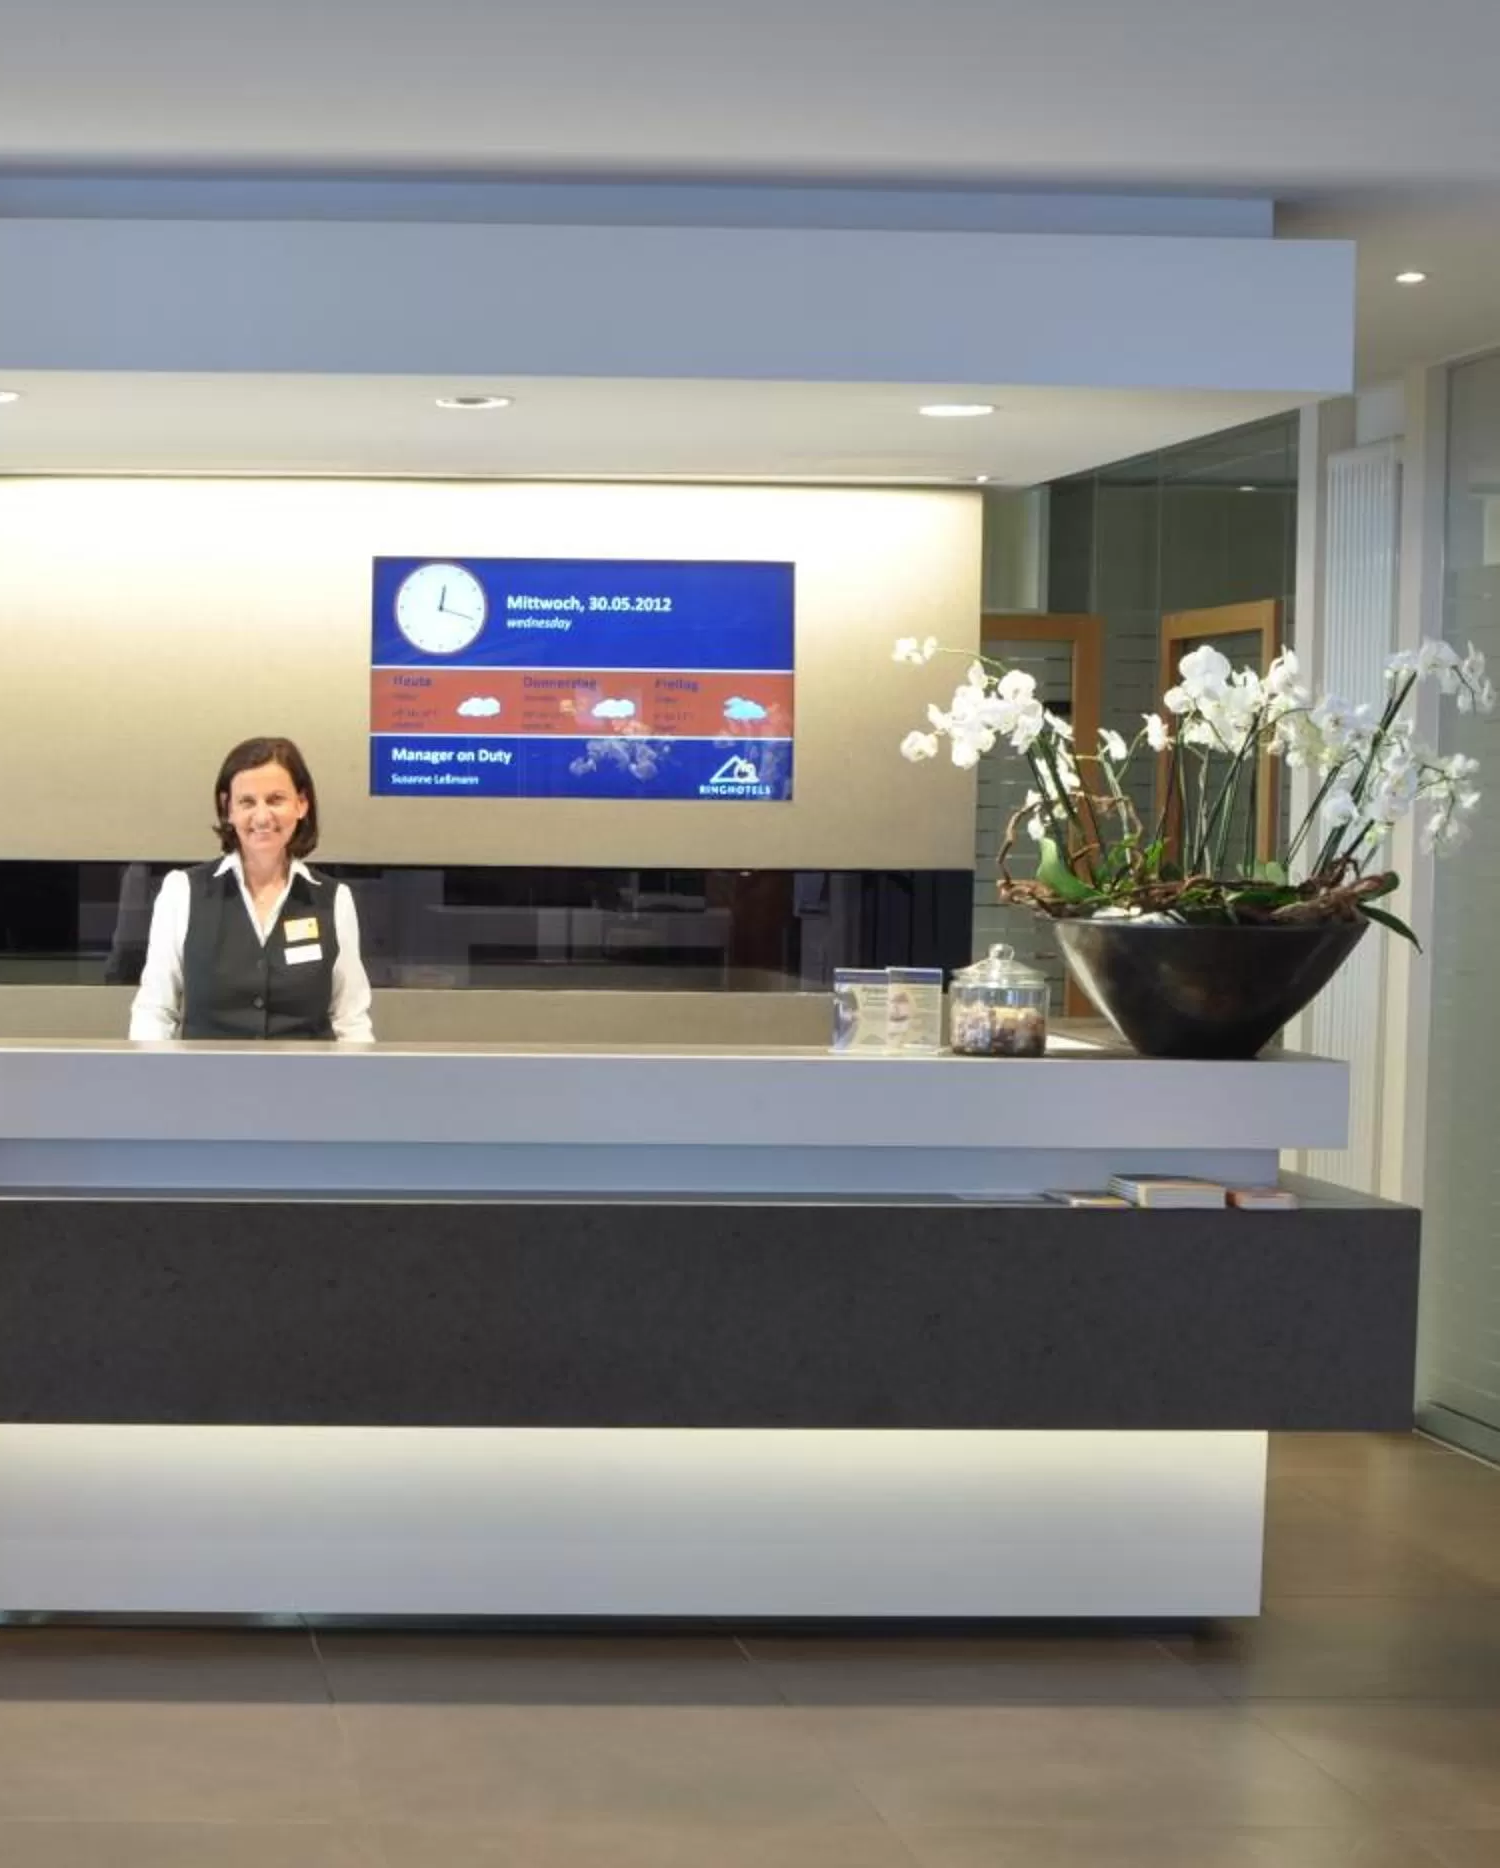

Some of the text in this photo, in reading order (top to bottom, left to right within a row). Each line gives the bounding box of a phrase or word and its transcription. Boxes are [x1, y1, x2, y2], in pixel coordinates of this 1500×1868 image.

[507, 595, 673, 613] Mittwoch, 30.05.2012
[507, 616, 572, 631] wednesday
[391, 747, 513, 765] Manager on Duty
[700, 785, 771, 795] RINGHOTELS
